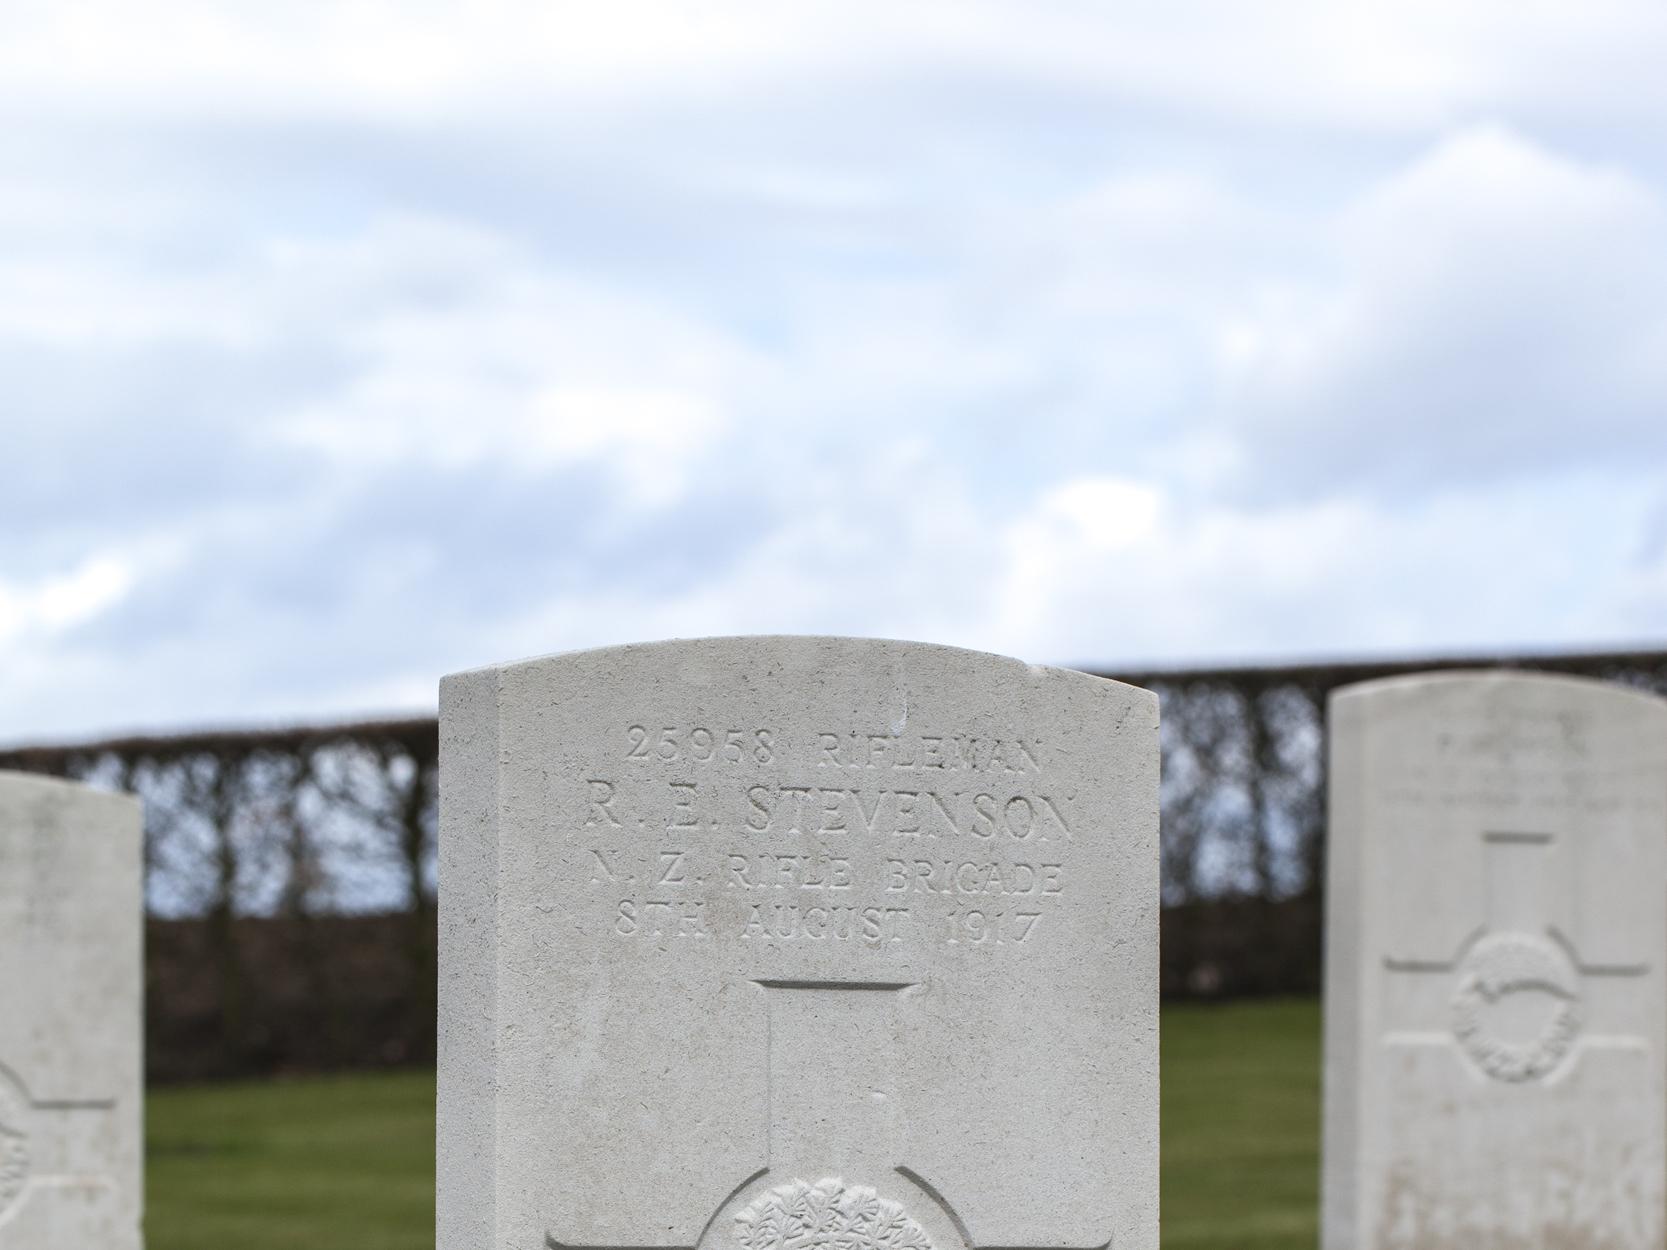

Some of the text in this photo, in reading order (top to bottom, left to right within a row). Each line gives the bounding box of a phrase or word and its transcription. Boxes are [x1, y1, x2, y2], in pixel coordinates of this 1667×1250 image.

[625, 724, 1044, 774] 25958 RIFLEMAN
[745, 785, 1077, 842] STEVENSON
[726, 854, 851, 891] RIFLE
[885, 858, 1063, 896] BRIGADE
[614, 900, 1043, 945] 8TH AUGUST 1917
